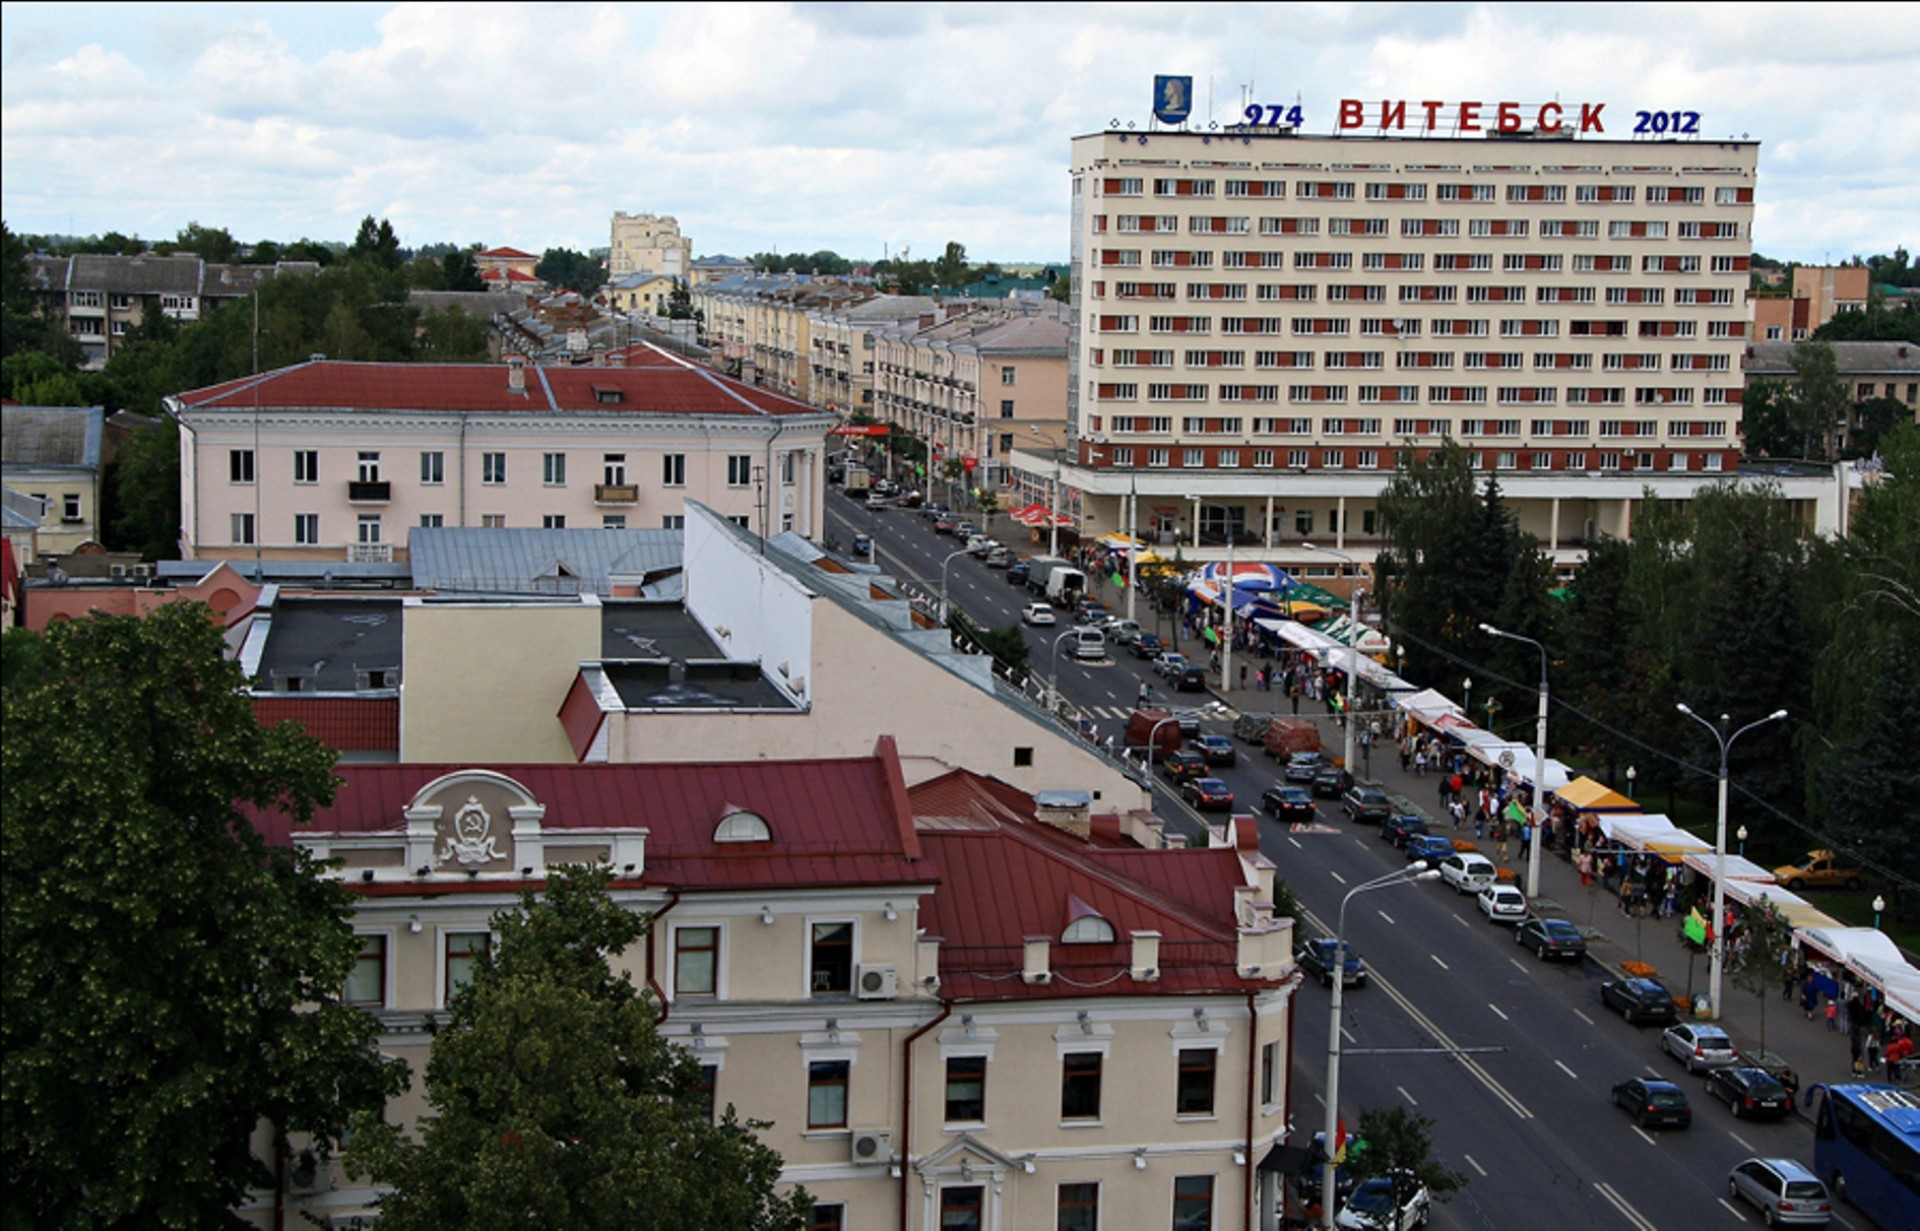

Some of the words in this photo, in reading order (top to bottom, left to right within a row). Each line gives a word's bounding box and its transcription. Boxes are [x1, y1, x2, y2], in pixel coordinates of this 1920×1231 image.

[1244, 104, 1304, 127] 974
[1339, 100, 1606, 132] ВИТЕБСК
[1633, 111, 1700, 133] 2012
